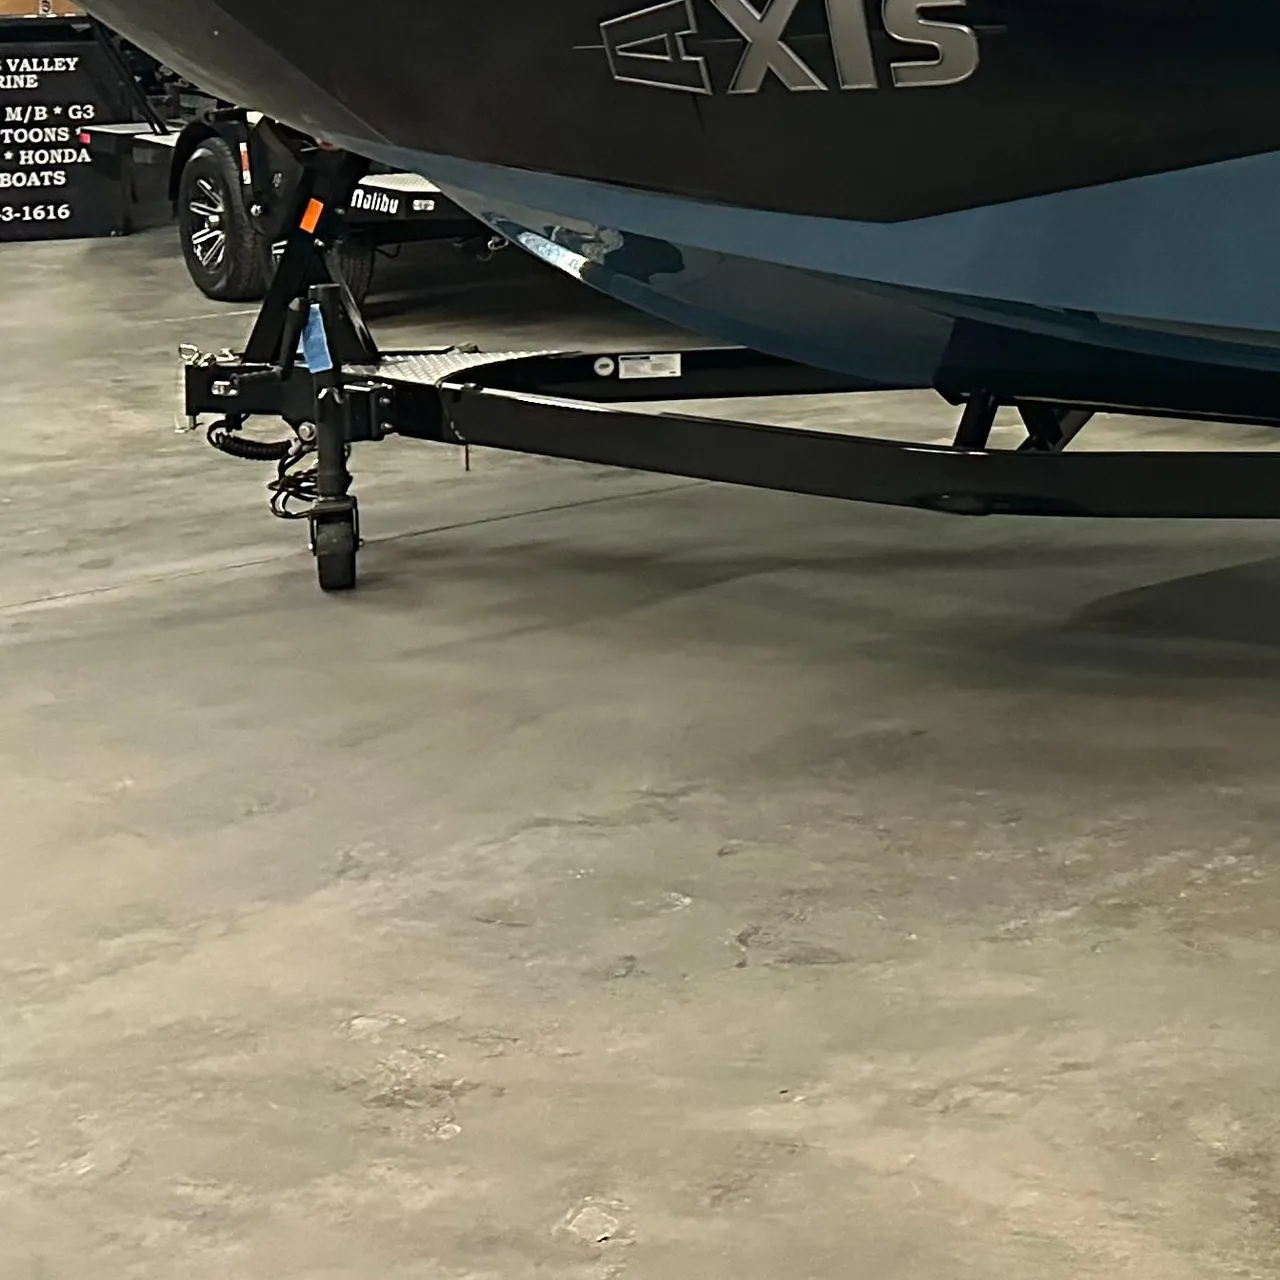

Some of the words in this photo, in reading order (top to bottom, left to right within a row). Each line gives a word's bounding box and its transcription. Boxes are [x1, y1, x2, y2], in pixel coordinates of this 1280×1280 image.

[6, 57, 79, 72] VALLEY
[5, 105, 48, 123] M/B
[67, 104, 95, 119] G3
[0, 127, 70, 143] TOONS
[19, 148, 92, 165] HONDA
[0, 171, 67, 187] BOATS
[0, 204, 70, 221] 3-1616
